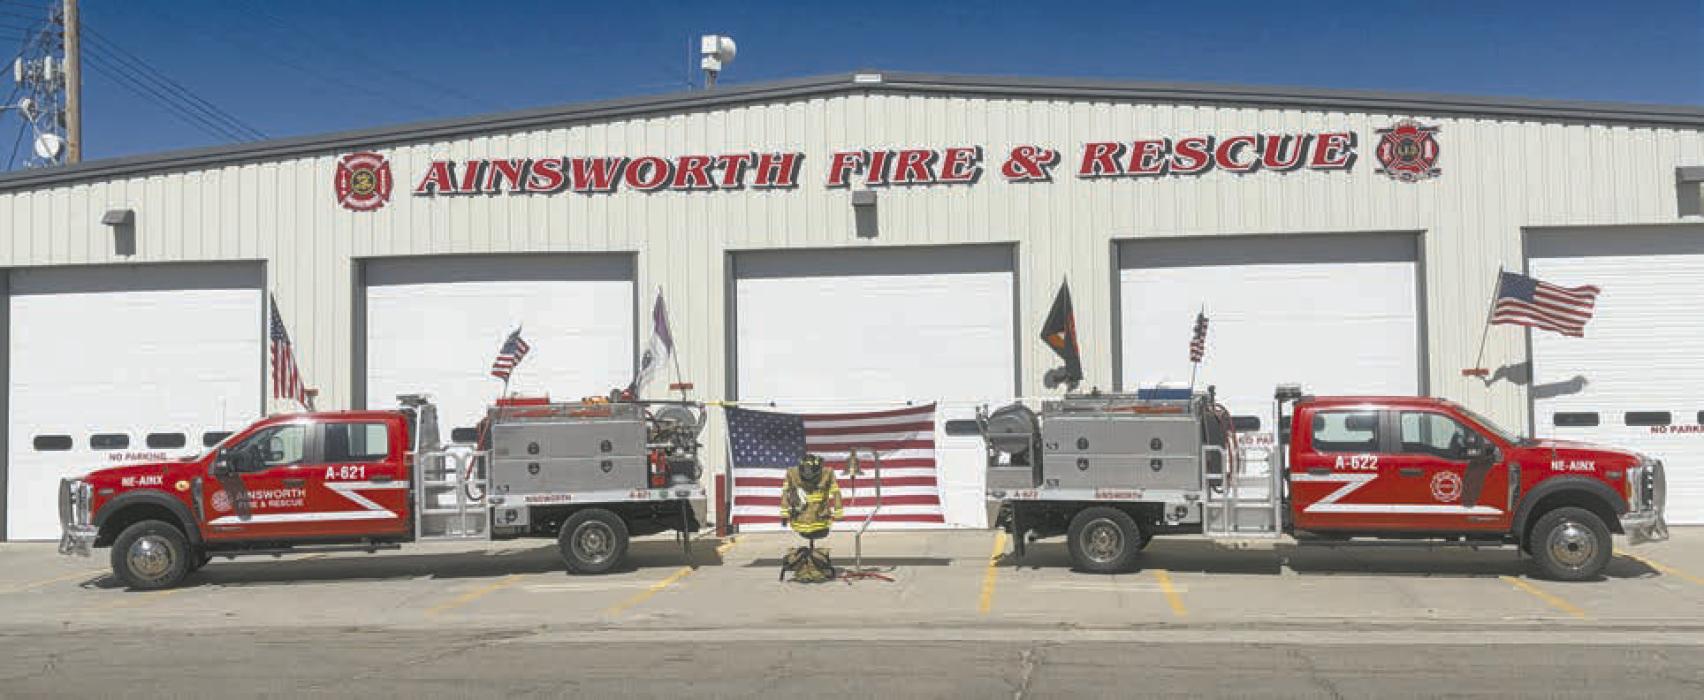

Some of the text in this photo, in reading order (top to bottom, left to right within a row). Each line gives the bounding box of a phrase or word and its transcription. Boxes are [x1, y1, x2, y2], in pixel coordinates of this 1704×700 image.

[413, 152, 805, 196] AINSWORTH
[826, 146, 983, 189] FIRE
[1001, 145, 1060, 183] &
[1078, 130, 1359, 179] RESCUE
[1650, 425, 1668, 434] NO
[109, 452, 167, 461] NO PARKING
[1334, 455, 1378, 470] A-622
[325, 465, 365, 480] A-621
[1551, 460, 1595, 472] NE-AINX
[121, 475, 164, 488] NE-AINX
[236, 488, 307, 501] AINSWORTH
[268, 499, 304, 508] RESCUE
